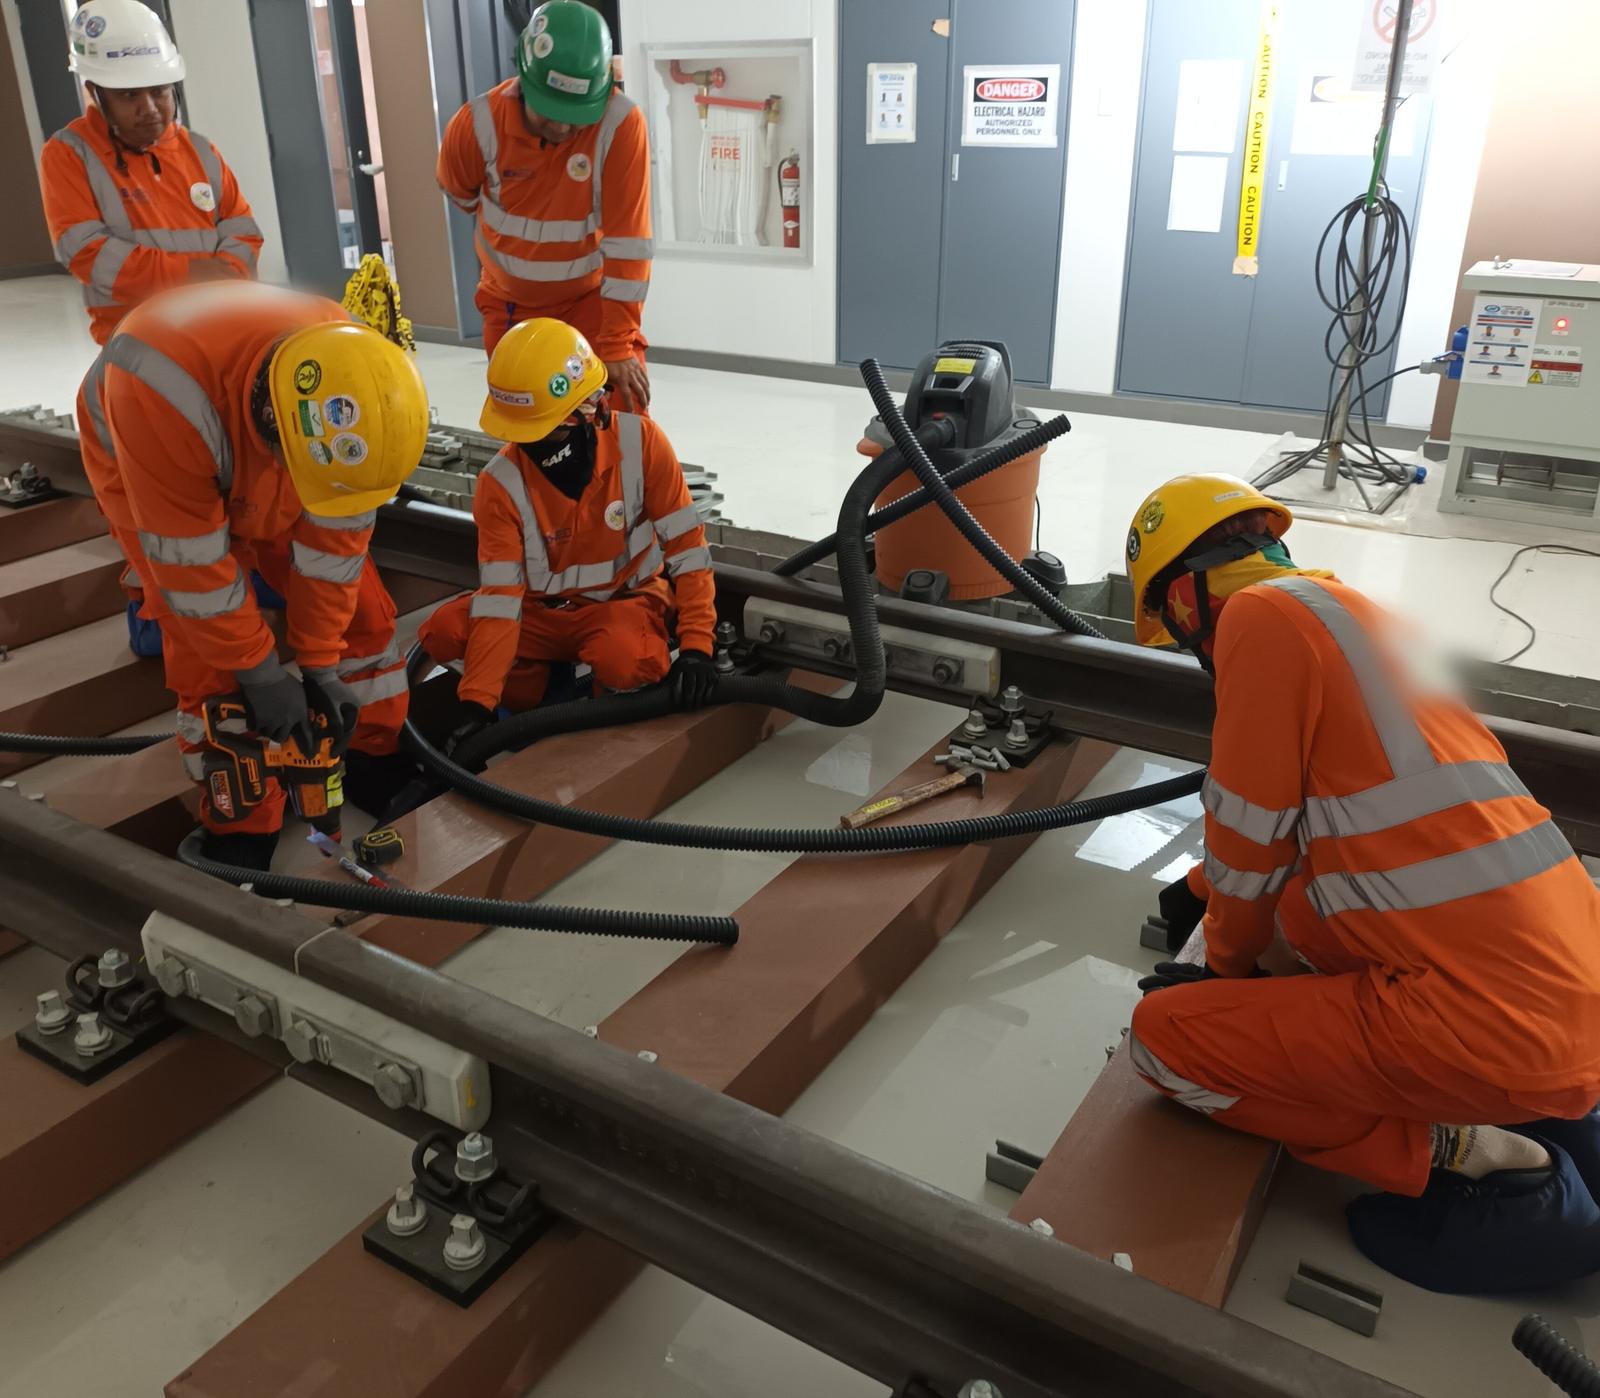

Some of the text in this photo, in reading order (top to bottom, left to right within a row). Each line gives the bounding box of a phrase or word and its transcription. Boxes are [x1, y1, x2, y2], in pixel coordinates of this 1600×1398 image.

[983, 82, 1039, 97] DANGER
[974, 106, 1046, 117] ELECTRICAL HAZARD
[985, 119, 1033, 127] AUTHORIZED
[976, 128, 1042, 136] PERSONNEL ONLY
[1250, 112, 1264, 173] CAUTION
[711, 147, 740, 160] FIRE
[1243, 186, 1257, 246] CAUTION
